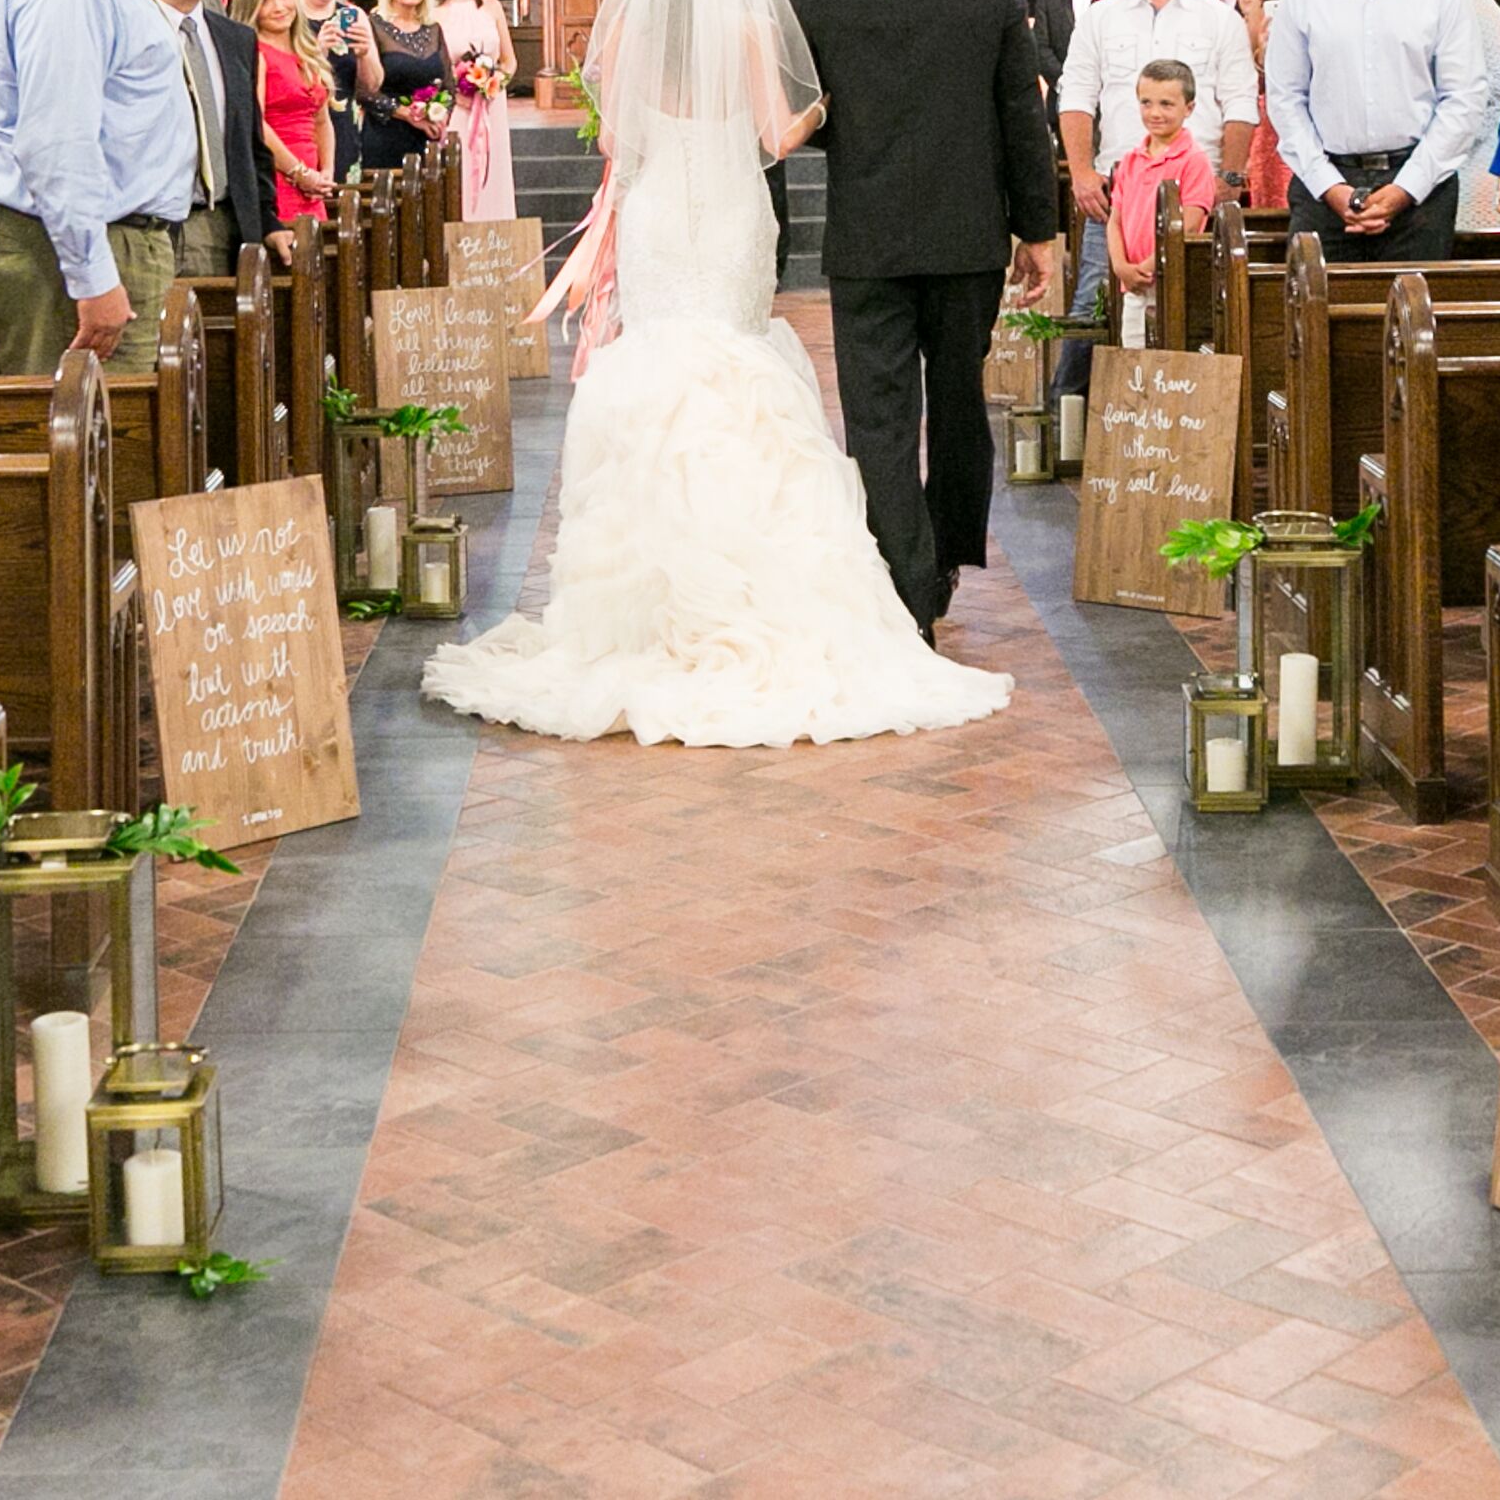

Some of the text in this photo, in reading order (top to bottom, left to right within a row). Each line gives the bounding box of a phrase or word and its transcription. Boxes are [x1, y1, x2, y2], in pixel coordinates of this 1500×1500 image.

[388, 299, 433, 335] Love
[396, 328, 493, 357] all things
[408, 353, 484, 375] believes
[1128, 365, 1197, 394] I have
[401, 376, 496, 400] all things
[1101, 402, 1206, 432] found the one
[1123, 434, 1180, 463] whom
[1087, 470, 1213, 504] my soul loves
[167, 516, 302, 579] Let us not
[153, 558, 318, 636] love with words
[242, 598, 314, 644] speech
[185, 641, 300, 706] but with
[200, 693, 294, 733] actions
[180, 718, 304, 774] and truth
